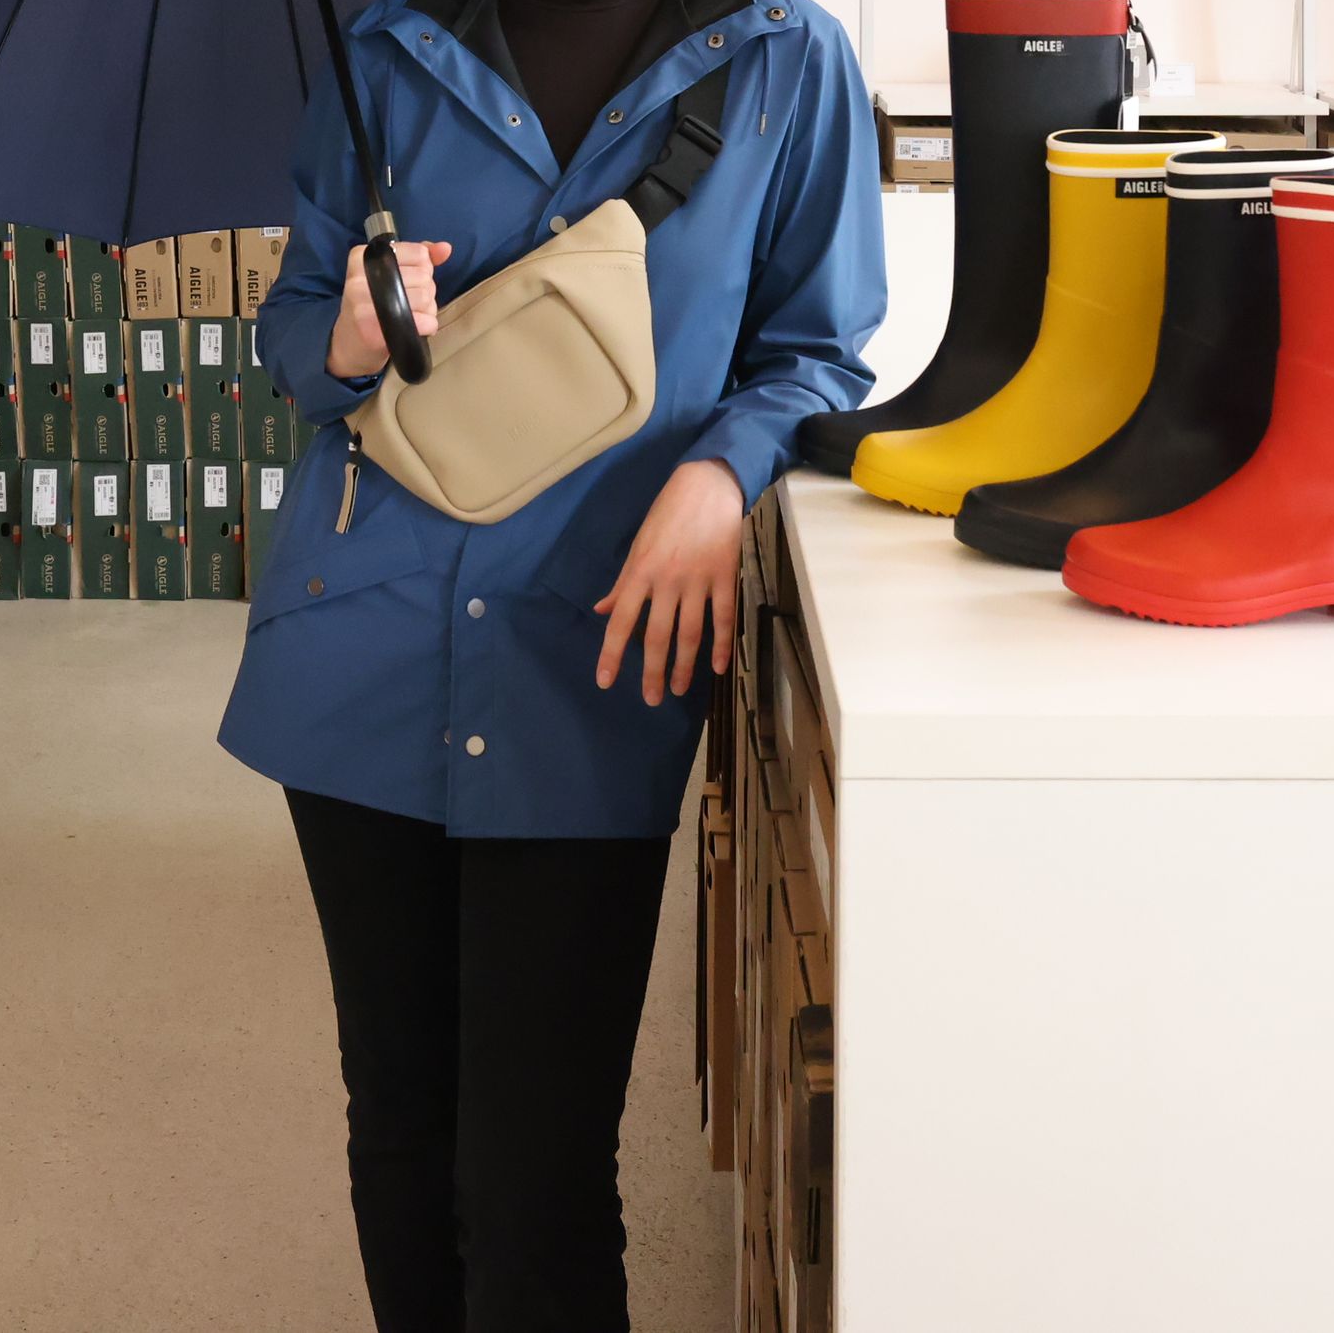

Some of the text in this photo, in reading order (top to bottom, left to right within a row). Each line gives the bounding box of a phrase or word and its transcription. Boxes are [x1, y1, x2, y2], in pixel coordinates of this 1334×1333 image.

[1024, 40, 1056, 52] AIGLE
[1123, 181, 1157, 194] AIGLE
[38, 282, 46, 310] AIGLE
[94, 281, 102, 312] AIGLE
[135, 268, 148, 301] AIGLE
[190, 267, 202, 300] AIGLE
[247, 269, 259, 302] AIGLE
[46, 425, 54, 452] AIGLE
[99, 426, 107, 453] AIGLE
[158, 426, 166, 453] AIGLE
[212, 421, 220, 451] AIGLE
[266, 426, 274, 454] AIGLE
